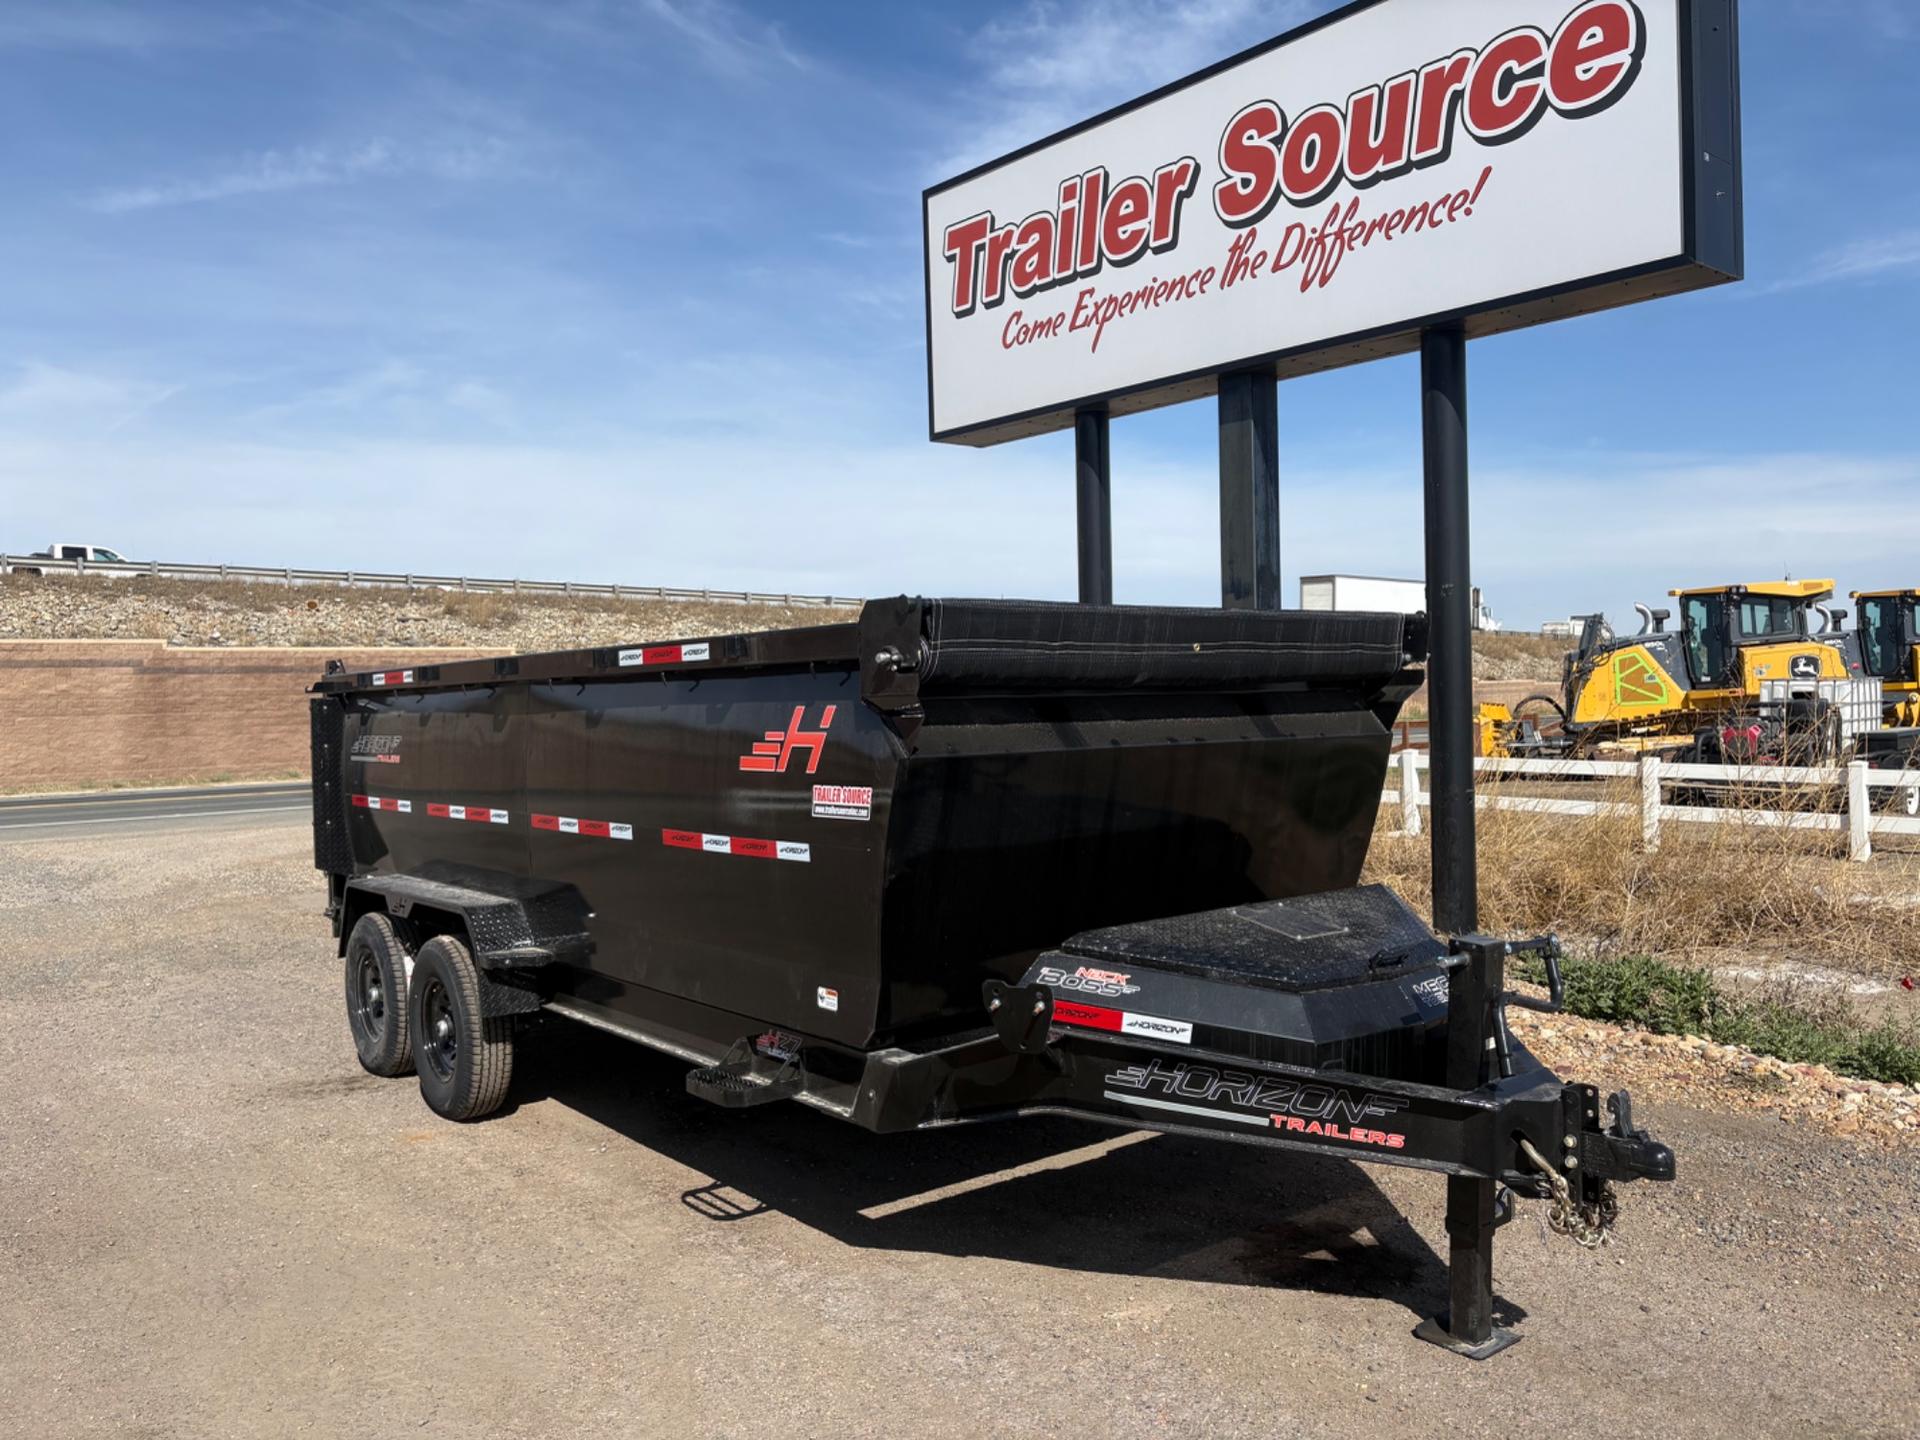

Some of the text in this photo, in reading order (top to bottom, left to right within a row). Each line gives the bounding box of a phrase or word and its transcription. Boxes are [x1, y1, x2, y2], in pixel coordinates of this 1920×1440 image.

[944, 0, 1647, 318] Trailer Source
[1001, 166, 1493, 353] Come Experience the Difference!
[814, 786, 871, 805] TRAILER SOURCE
[1036, 967, 1122, 997] BOSS
[1074, 966, 1131, 985] NECK
[1129, 1020, 1186, 1035] HORIZON
[1137, 1058, 1372, 1124] HORIZON
[1270, 1114, 1405, 1149] TRAILERS
